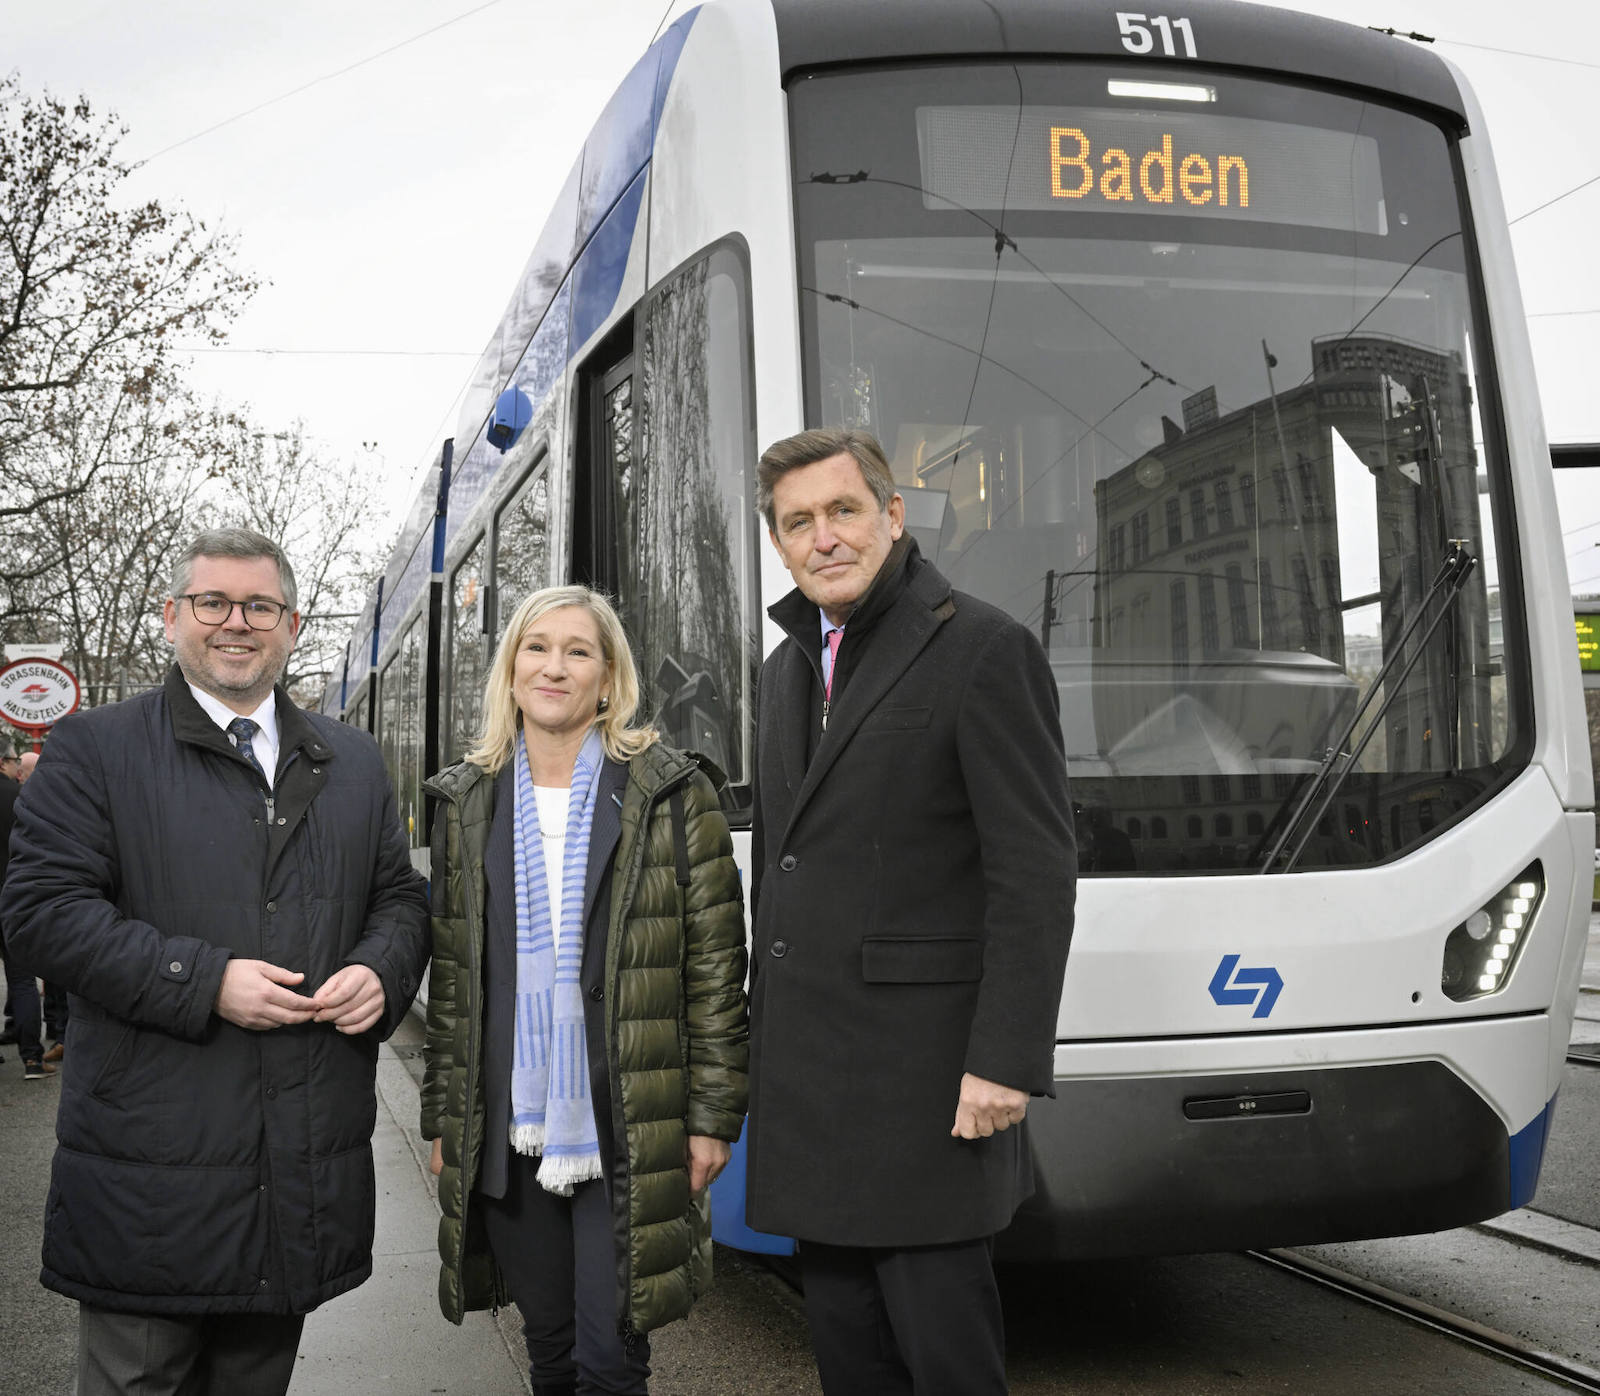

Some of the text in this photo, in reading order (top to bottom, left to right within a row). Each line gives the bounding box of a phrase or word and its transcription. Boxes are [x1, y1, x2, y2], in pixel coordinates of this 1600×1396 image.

[1116, 12, 1197, 58] 511
[1050, 126, 1249, 207] Baden
[1, 666, 70, 690] STRASSENBAHN
[4, 700, 67, 720] HALTESTELLE
